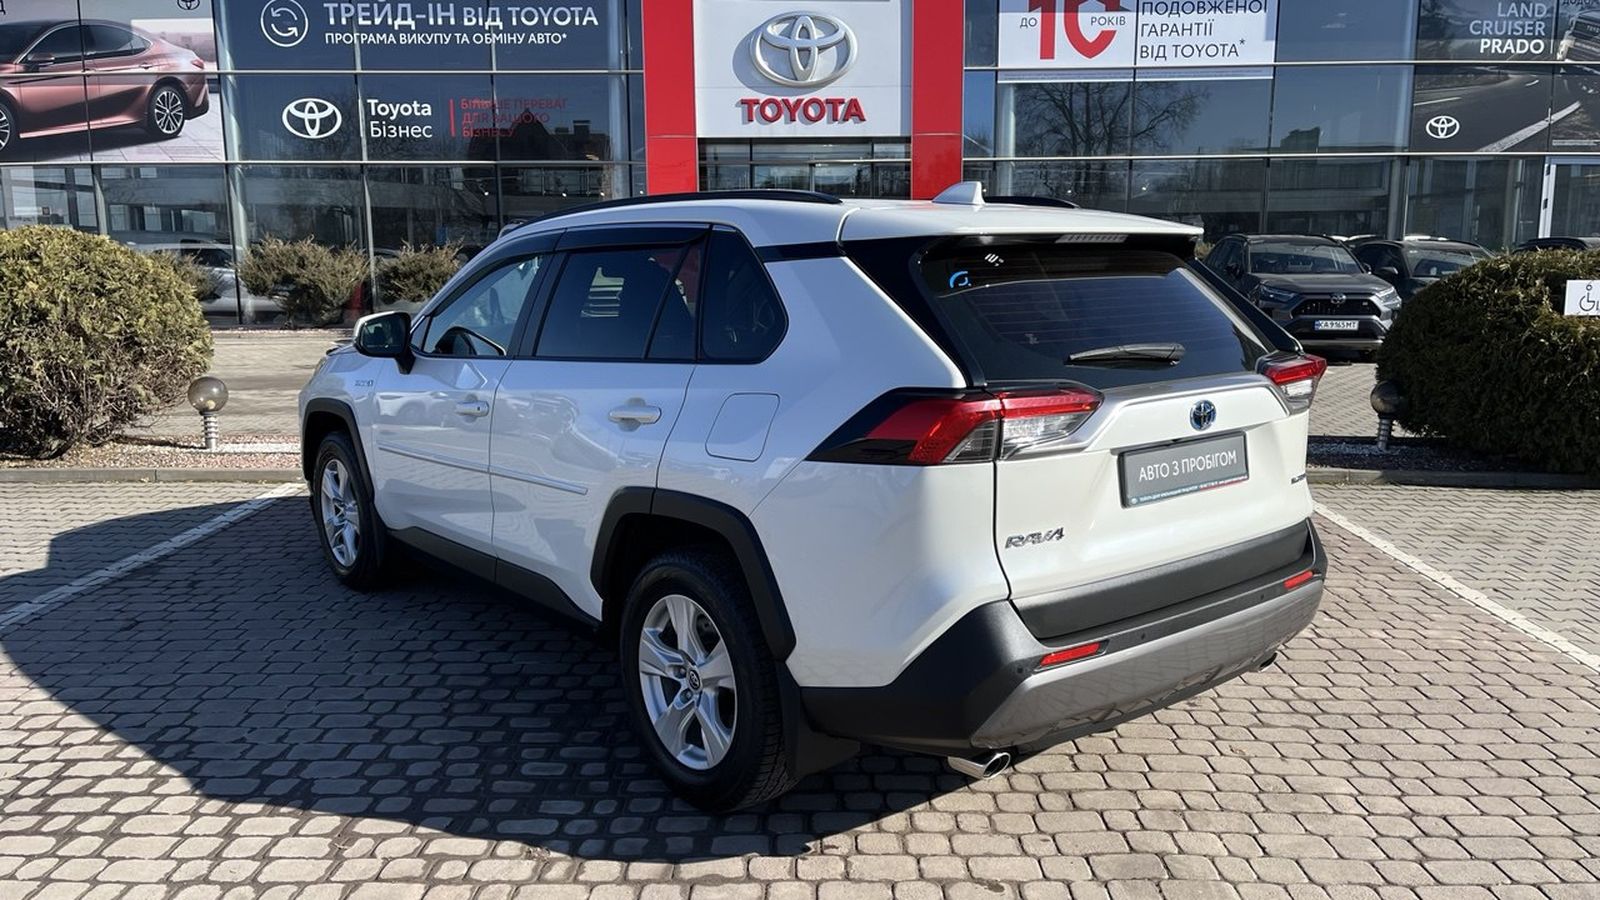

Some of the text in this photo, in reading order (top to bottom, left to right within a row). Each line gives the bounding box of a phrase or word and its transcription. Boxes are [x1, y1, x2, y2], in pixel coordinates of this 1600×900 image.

[323, 0, 599, 30] ТРЕЙД-ІН ВІД TOYOTA
[1497, 2, 1547, 18] LAND
[1020, 17, 1038, 28] ДО
[1090, 15, 1126, 27] РОКІВ
[1140, 19, 1214, 37] ГАРАНТІЇ
[1469, 20, 1546, 36] CRUISER
[325, 32, 397, 45] ПРОГРАМА
[400, 33, 451, 45] ВИКУПУ
[453, 33, 470, 44] ТА
[472, 33, 526, 45] ОБМІНУ
[1479, 39, 1545, 54] PRADO
[1140, 45, 1167, 61] ВІД
[366, 99, 432, 121] Toyota
[740, 98, 866, 122] TOYOTA
[370, 121, 433, 139] Бізнес
[1138, 450, 1237, 482] АВТО З ПРОБІГОМ
[1005, 526, 1065, 549] RAV4
